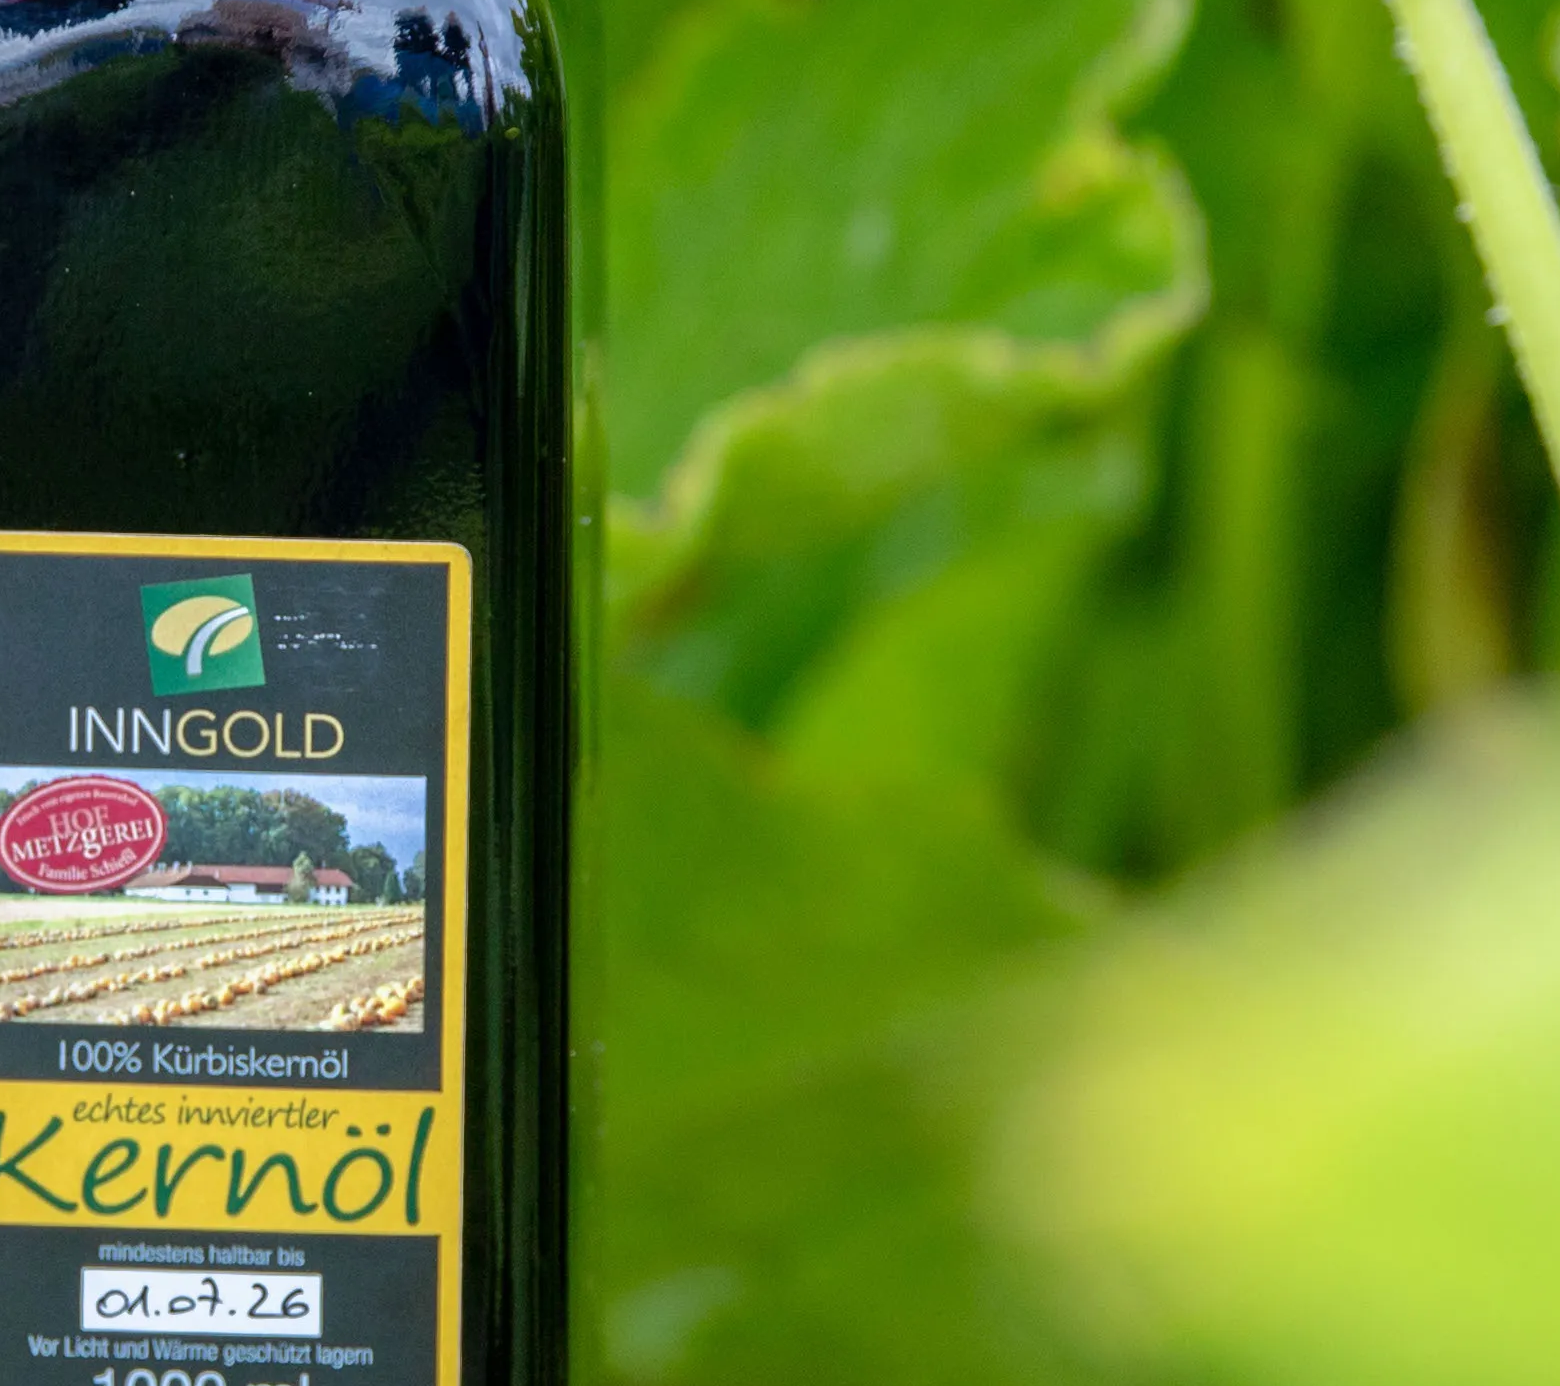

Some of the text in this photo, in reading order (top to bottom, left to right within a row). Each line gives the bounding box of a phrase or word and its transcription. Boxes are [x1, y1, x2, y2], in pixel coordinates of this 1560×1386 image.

[69, 706, 345, 760] INNGOLD
[48, 804, 110, 839] HOF
[58, 1039, 350, 1080] 100% Kürbiskernöl
[72, 1093, 340, 1131] echtes innviertler
[98, 1243, 306, 1267] mindestens haltbar bis
[95, 1276, 311, 1319] 01.07.26
[27, 1333, 375, 1369] Vor Licht und Wärme geschützt lagern
